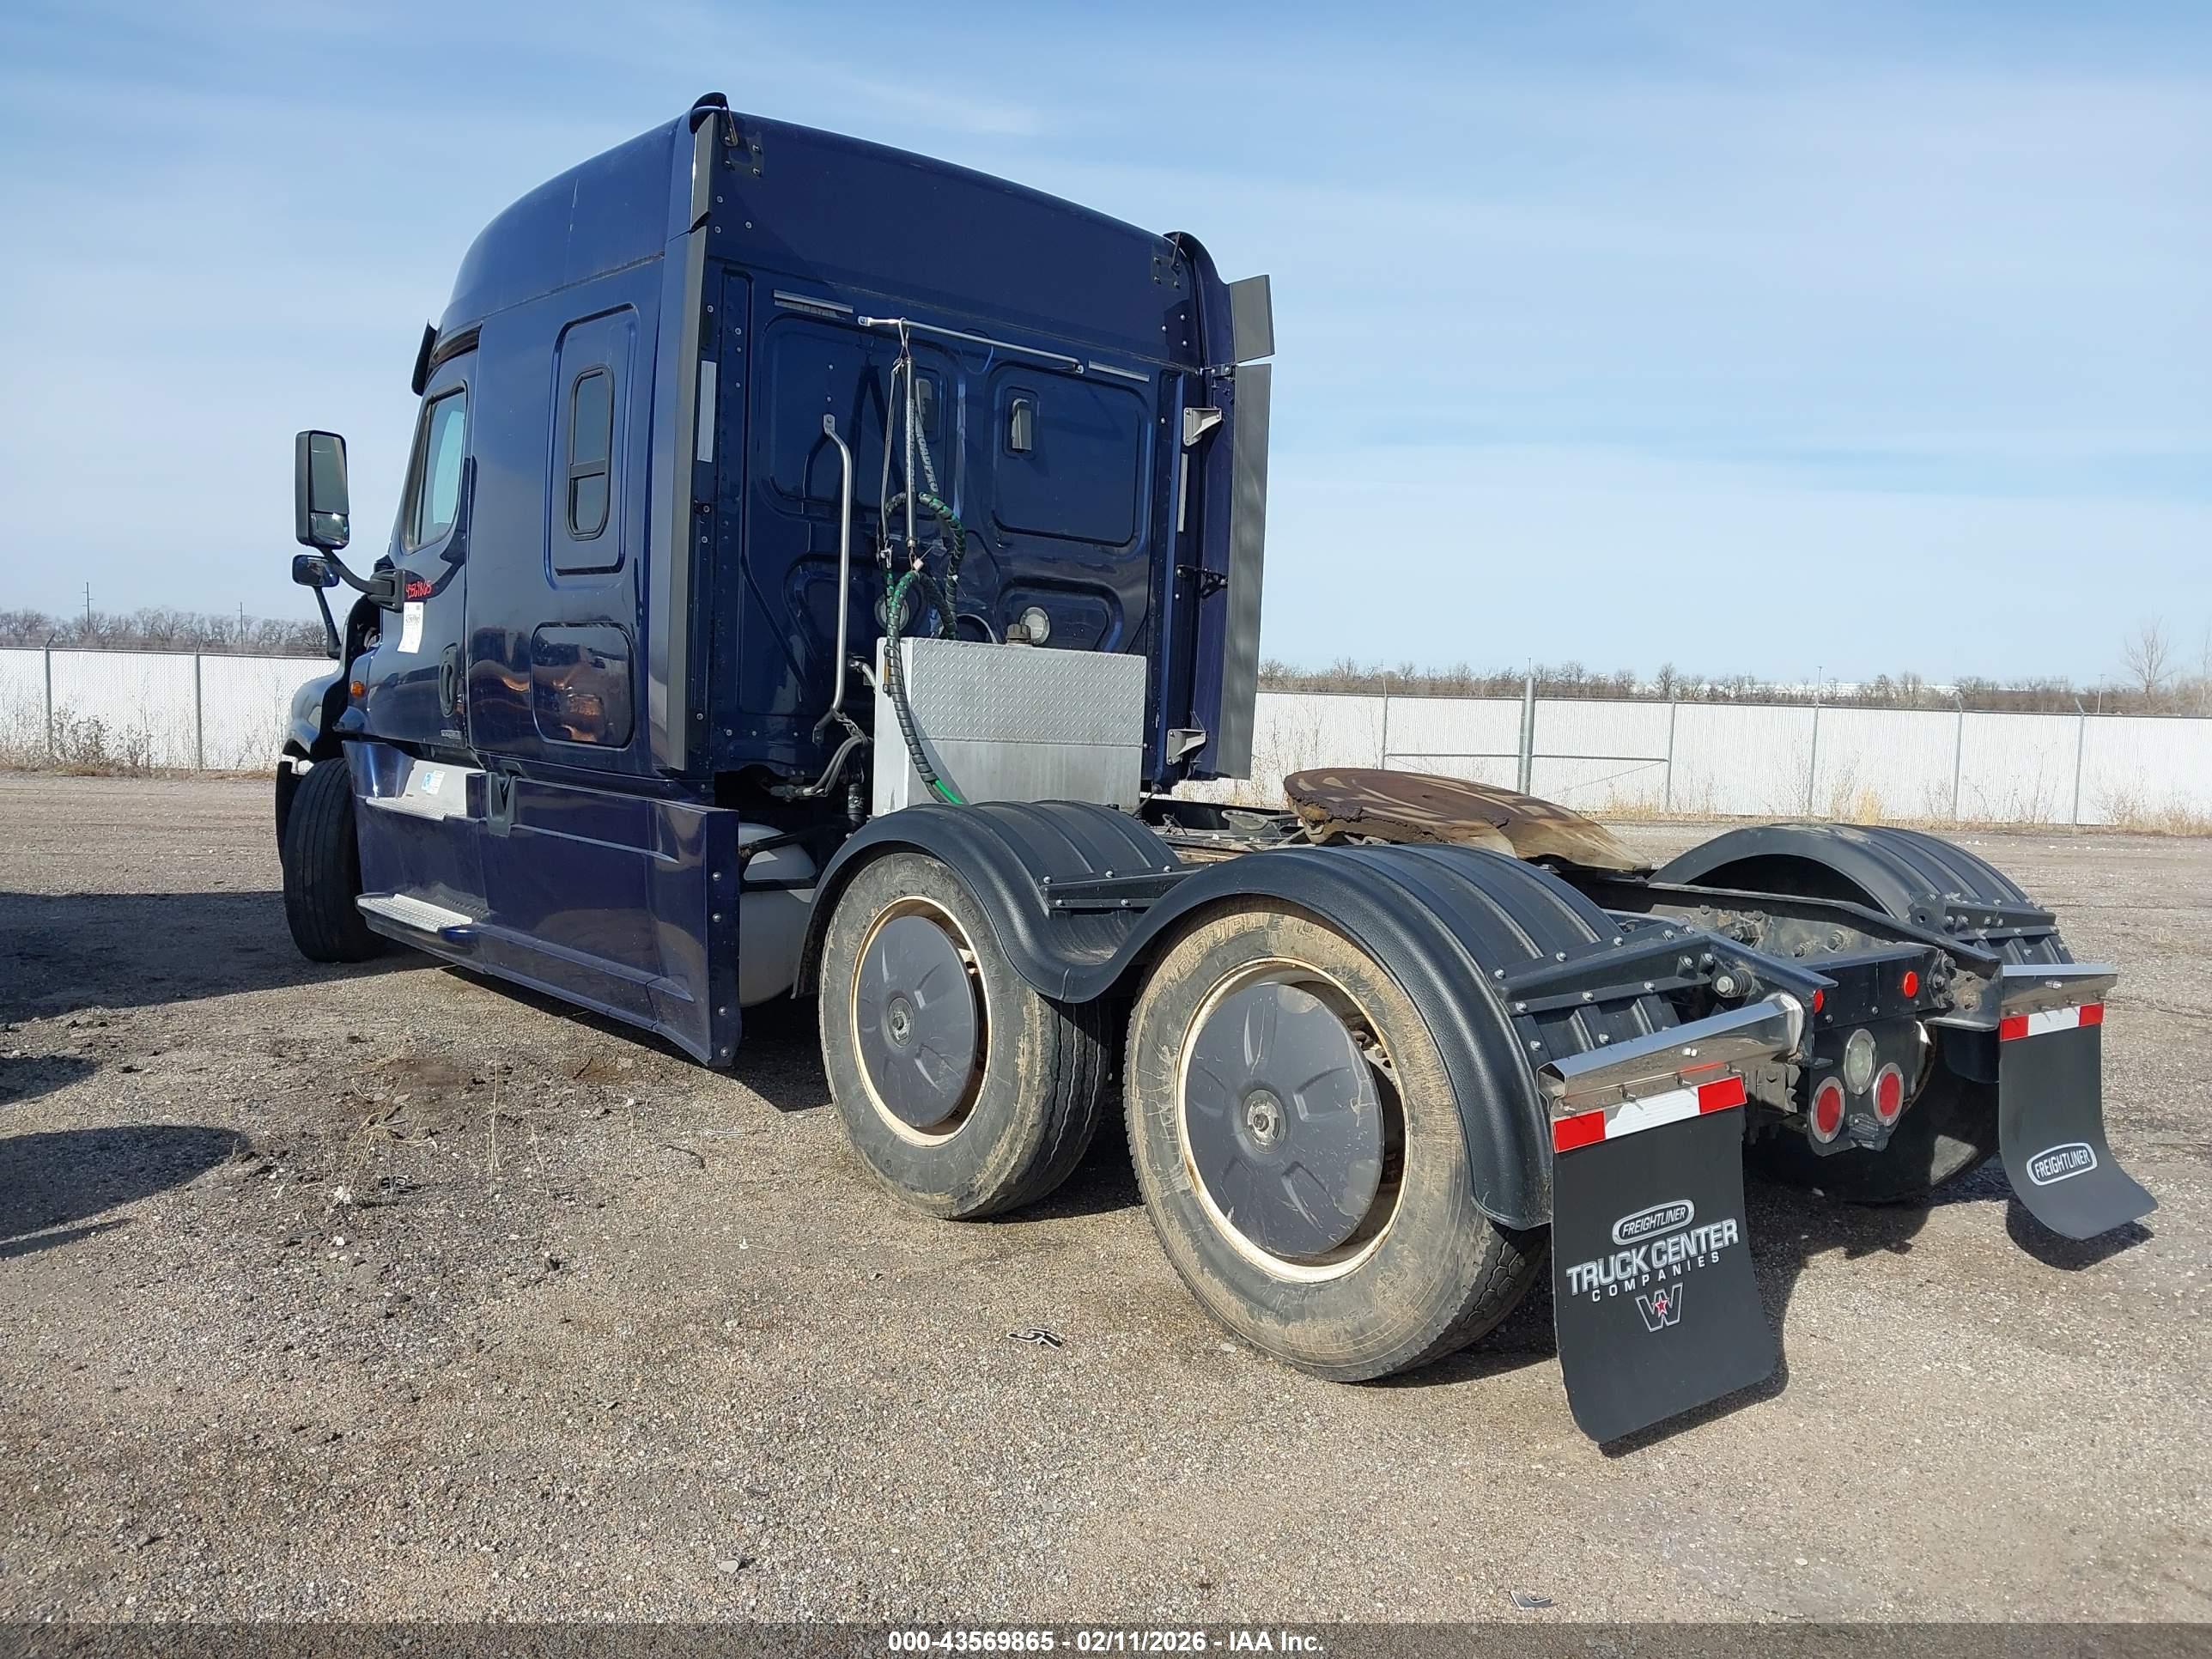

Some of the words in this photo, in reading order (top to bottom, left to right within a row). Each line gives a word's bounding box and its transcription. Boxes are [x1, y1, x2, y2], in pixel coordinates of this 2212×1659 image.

[916, 431, 939, 493] ROADPRO
[2034, 1148, 2091, 1180] FREIGHTLINER
[1621, 1206, 1686, 1238] FREIGHTLINER
[1565, 1244, 1652, 1297] TRUCK
[1651, 1218, 1739, 1267] CENTER
[1591, 1251, 1722, 1304] COMPANIES
